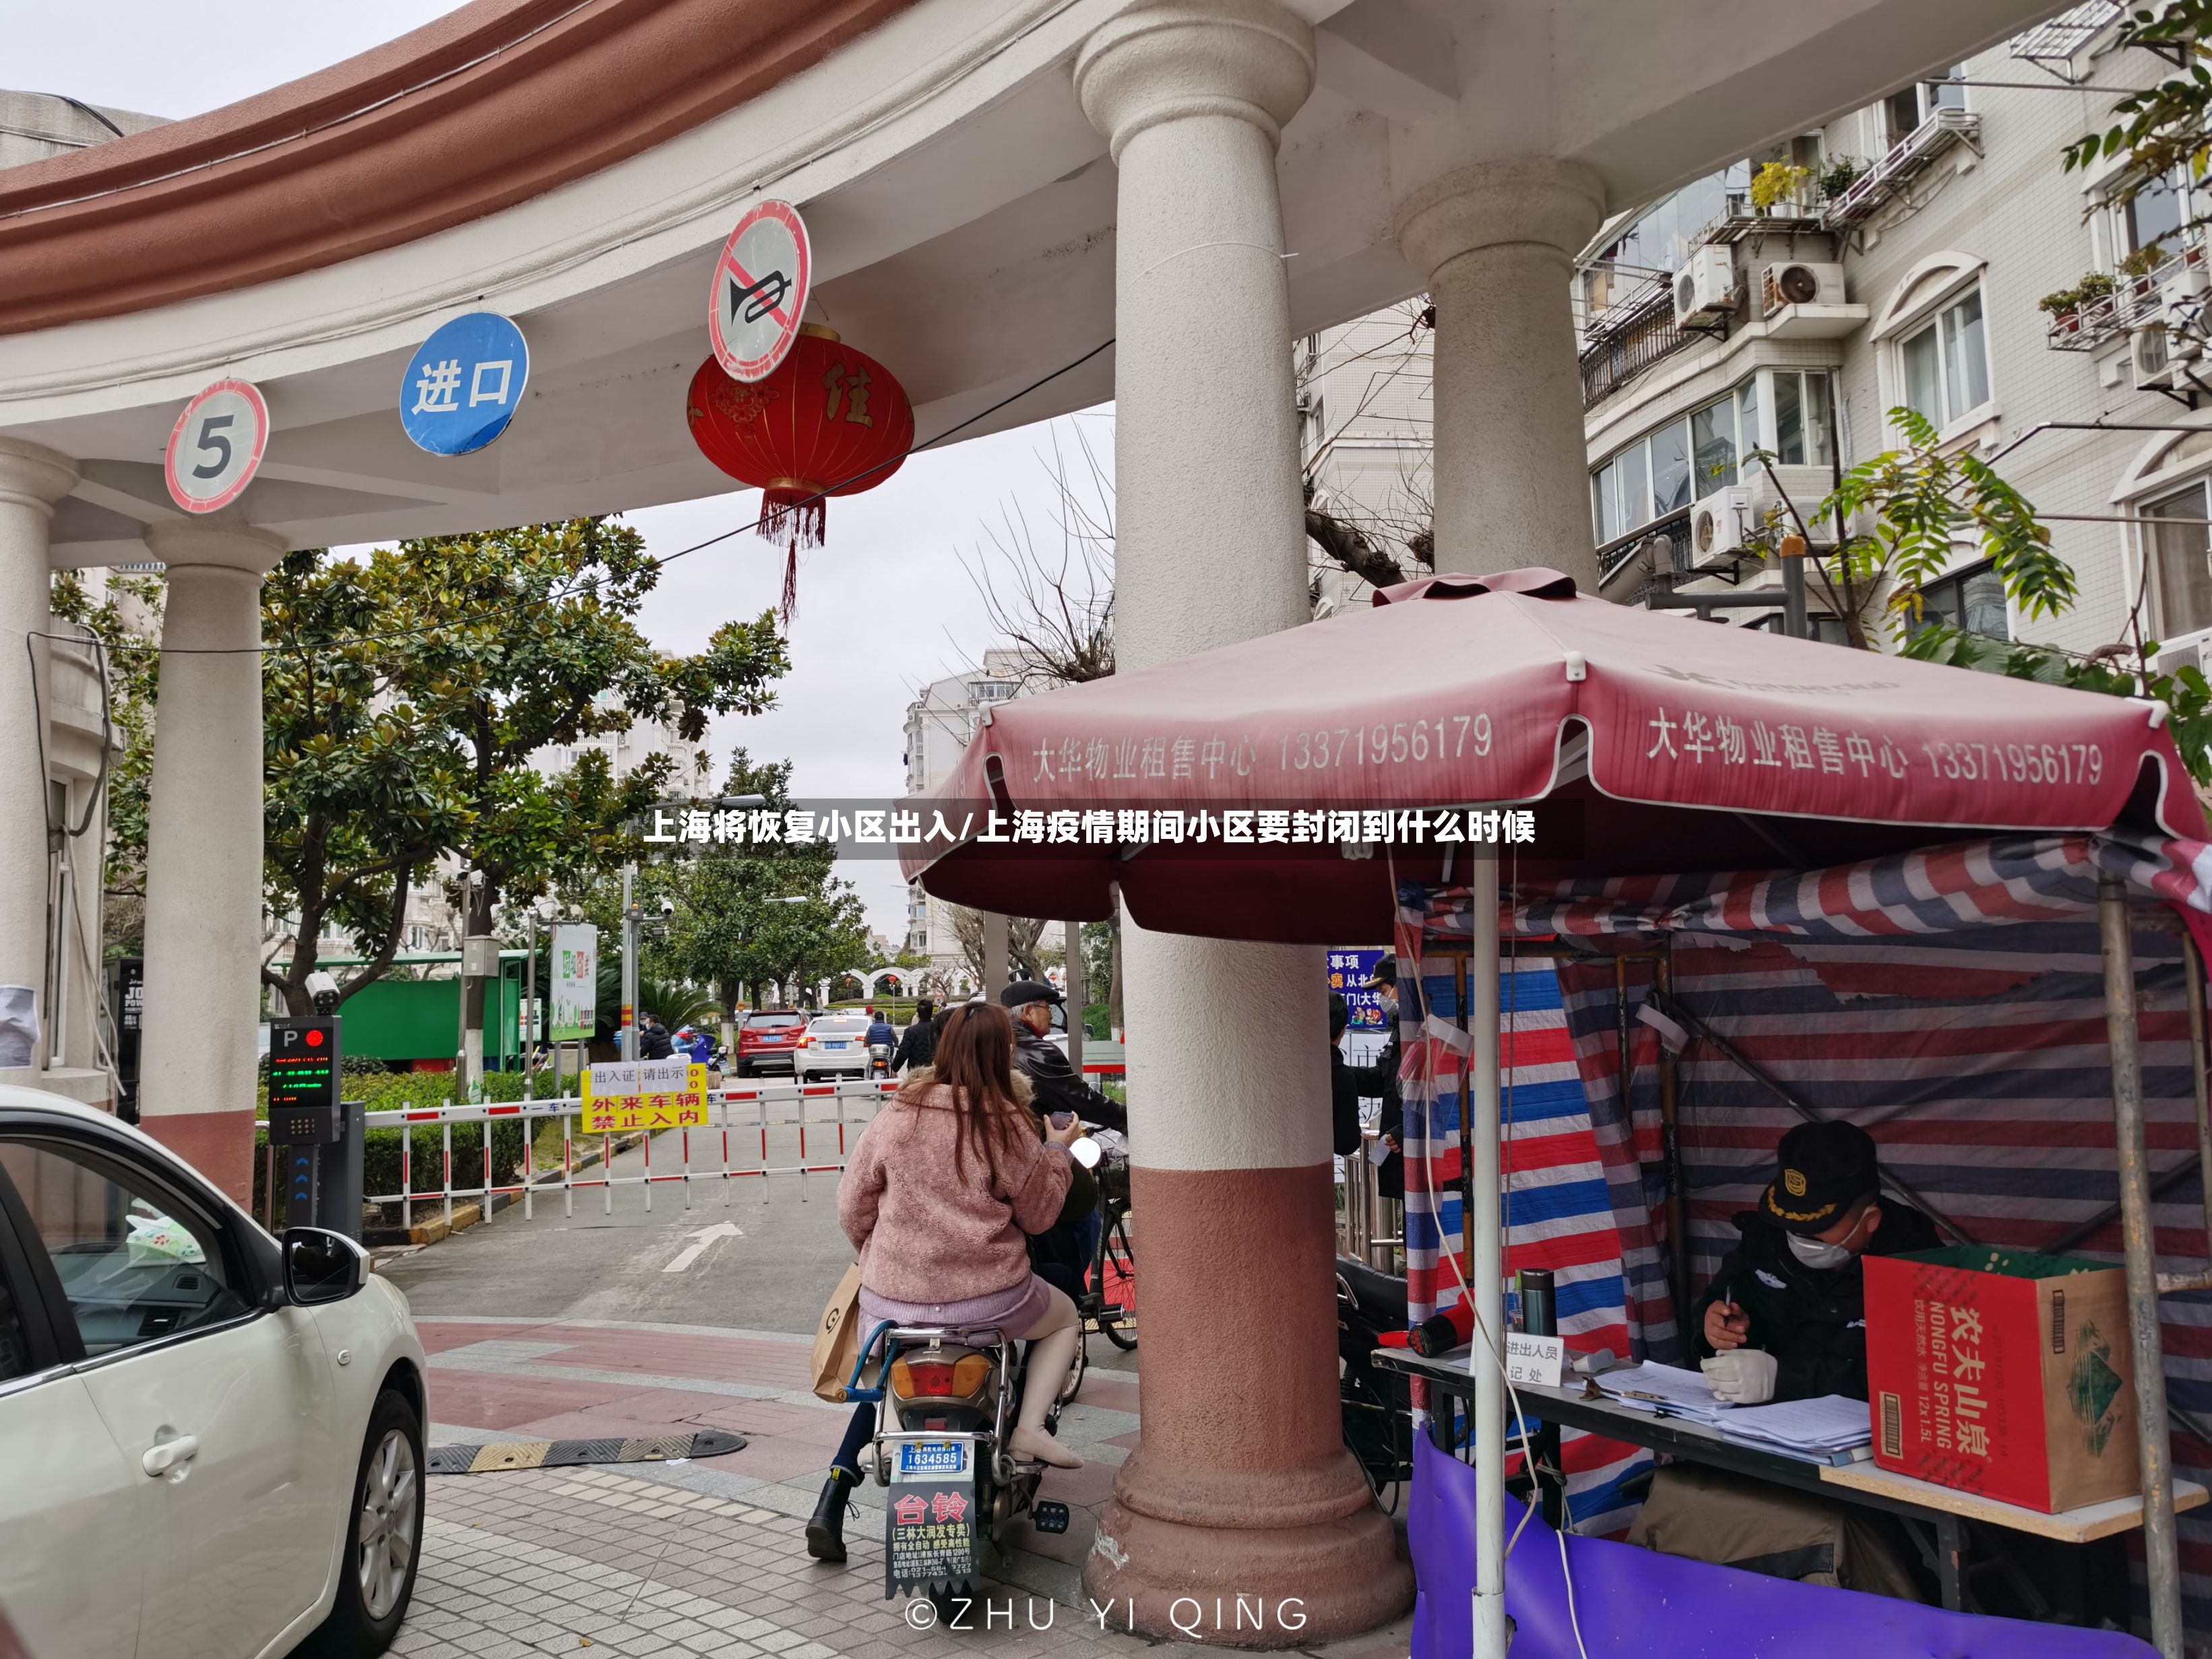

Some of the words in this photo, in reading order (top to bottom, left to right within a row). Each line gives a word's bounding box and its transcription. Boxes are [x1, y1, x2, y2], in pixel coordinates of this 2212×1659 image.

[411, 358, 513, 416] 进口
[191, 414, 232, 480] 5
[1033, 734, 1256, 783] 大华物业租售中心
[1279, 713, 1492, 771] 13371956179
[1647, 706, 1908, 778] 大华物业租售中心
[1921, 742, 2103, 785] 13371956179
[1327, 955, 1359, 969] 事项
[284, 1030, 298, 1047] P
[595, 1070, 635, 1084] 出入证
[643, 1066, 684, 1080] 请出示
[592, 1093, 700, 1112] 外来车辆
[592, 1110, 699, 1129] 禁止入内
[1914, 1299, 1927, 1357] 饮用天然水
[1930, 1301, 1949, 1375] NONGFU
[1507, 1341, 1558, 1360] 进出人员
[1951, 1307, 1991, 1457] 农夫山泉
[1934, 1381, 1952, 1449] SPRING
[908, 1453, 957, 1464] 1634585
[893, 1491, 968, 1526] 台铃
[893, 1523, 970, 1541] (三林大润发专卖)
[893, 1540, 930, 1551] 拥有全自动
[933, 1538, 970, 1549] 感受高性能
